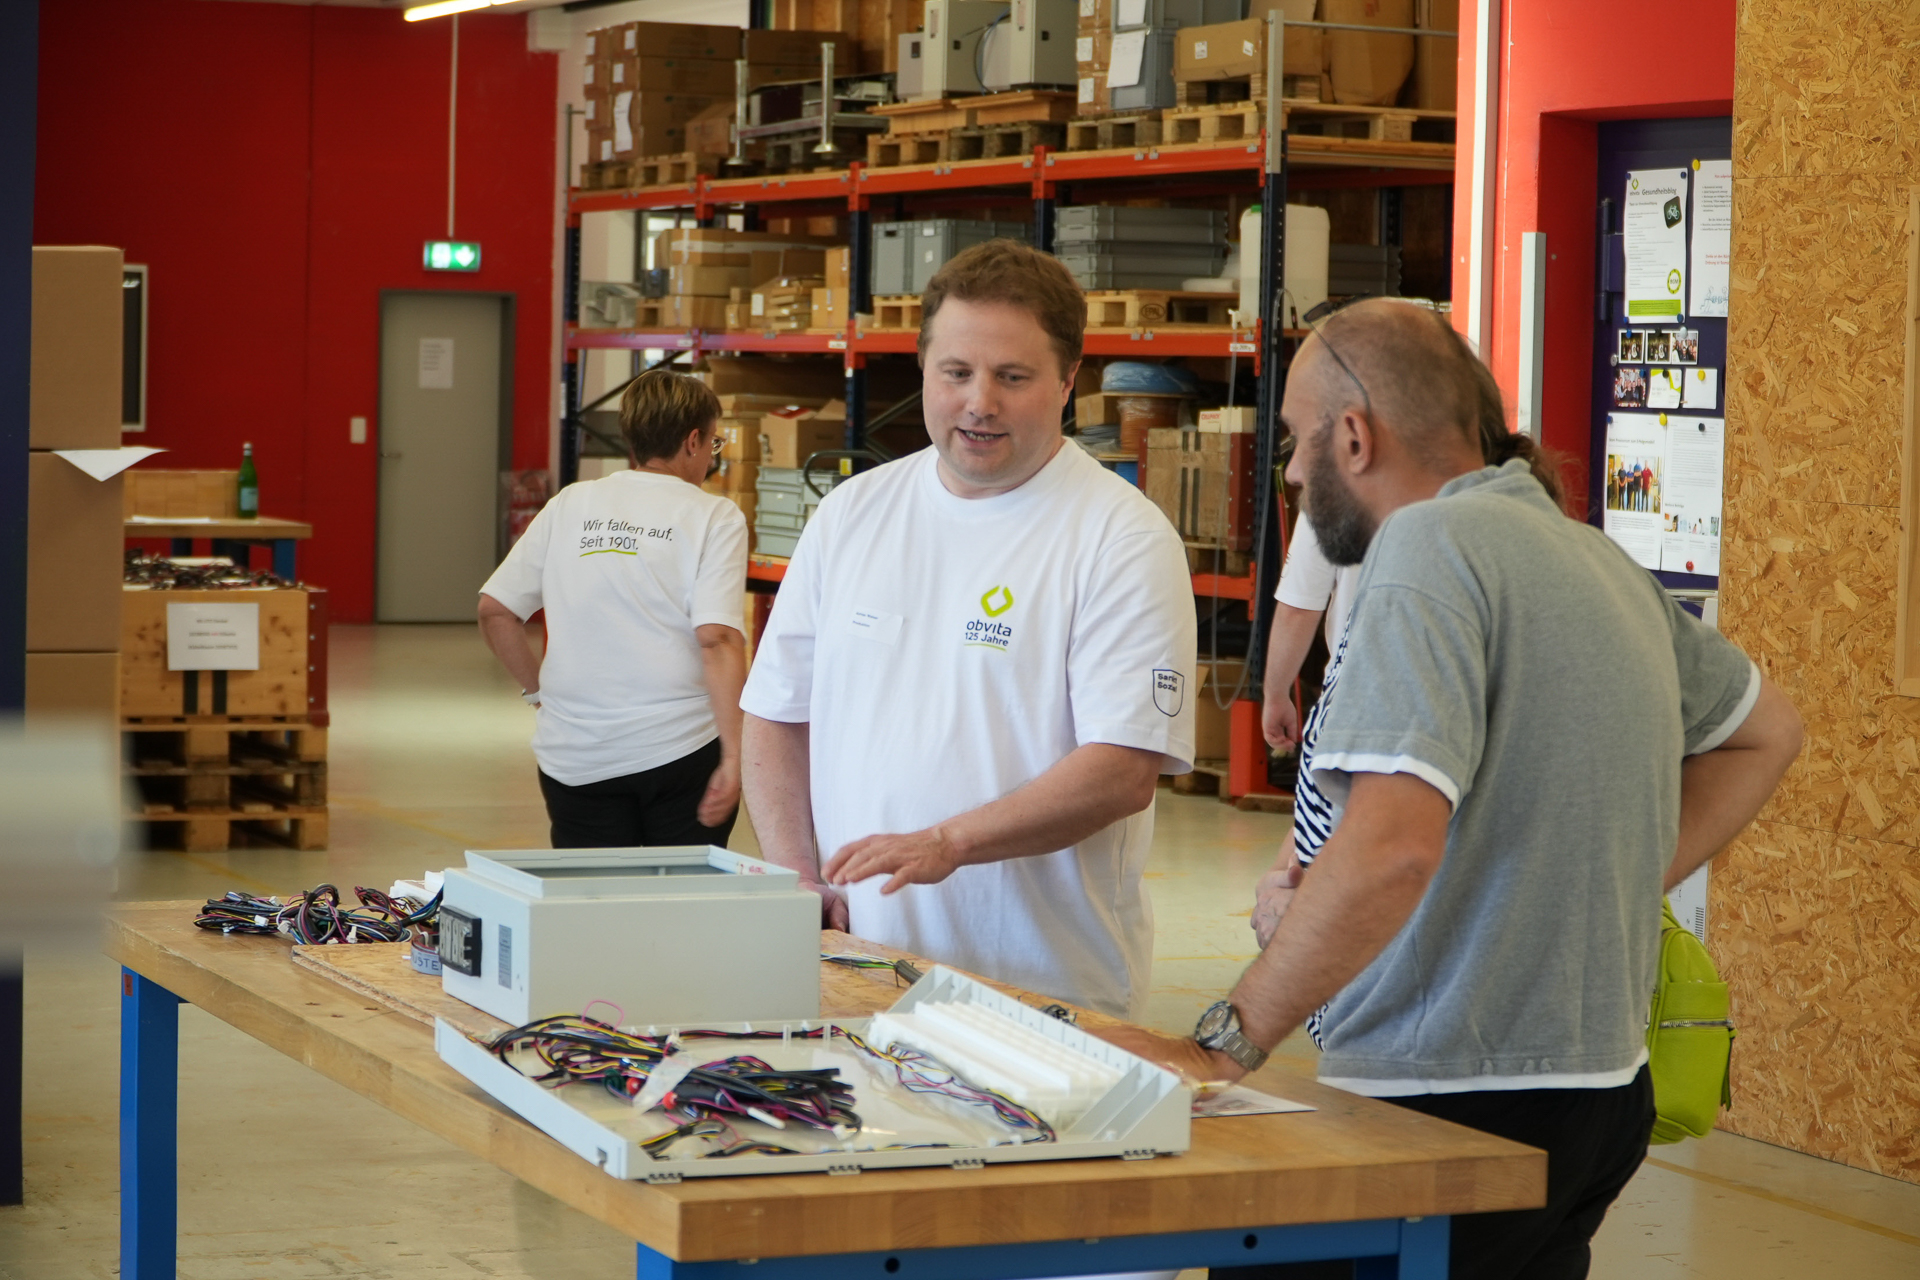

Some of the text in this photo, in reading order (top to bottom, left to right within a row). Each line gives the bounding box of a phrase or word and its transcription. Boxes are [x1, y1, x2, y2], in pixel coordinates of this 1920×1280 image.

[1641, 187, 1677, 195] Gesundheitsblog
[583, 518, 673, 541] Wir fallen auf.
[579, 535, 639, 550] Seit 1901.
[966, 619, 1012, 637] obvita
[965, 632, 1009, 647] 125 Jahre
